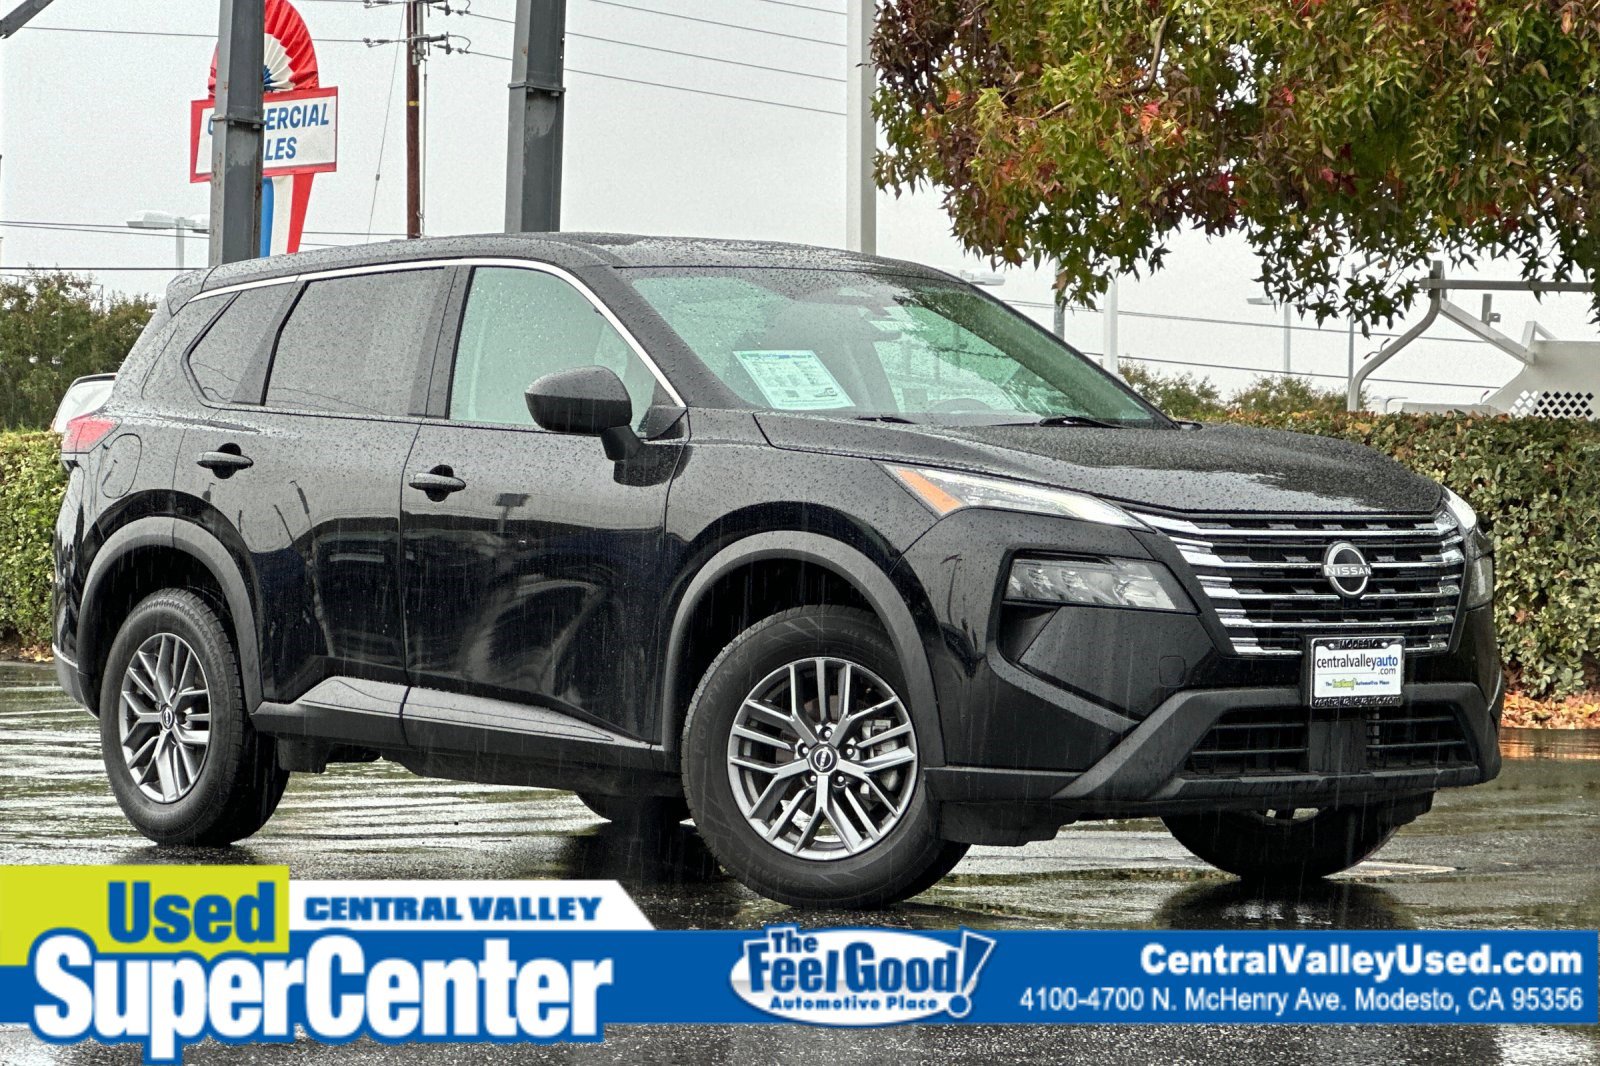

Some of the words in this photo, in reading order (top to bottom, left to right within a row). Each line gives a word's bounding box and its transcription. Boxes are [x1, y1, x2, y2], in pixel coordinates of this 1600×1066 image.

[264, 136, 297, 160] LES
[1325, 566, 1371, 576] NISSAN
[1316, 653, 1398, 670] centralvalleyauto
[1378, 667, 1396, 675] .com
